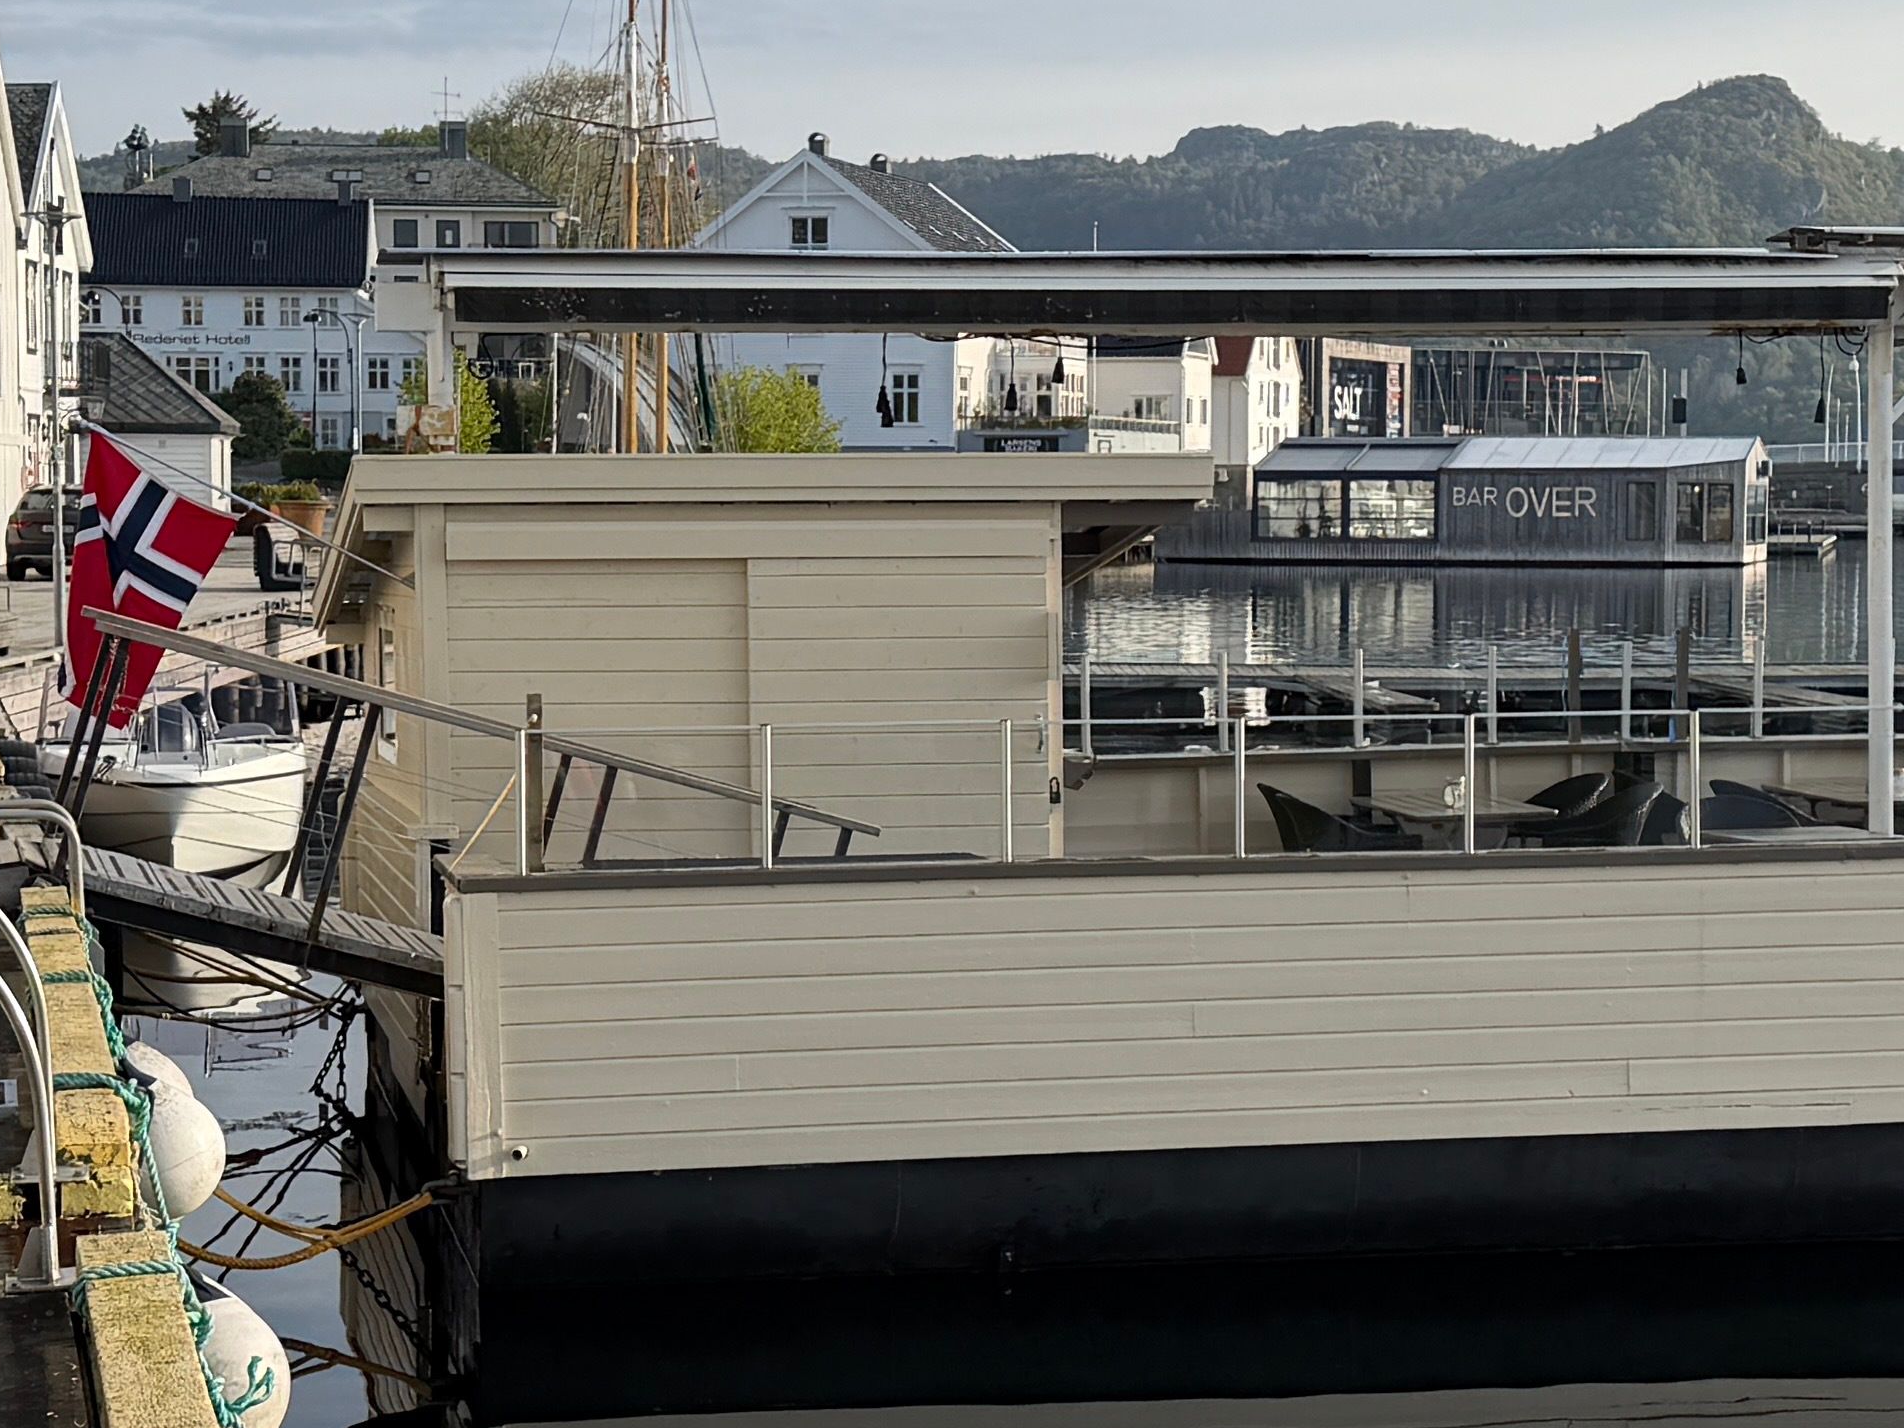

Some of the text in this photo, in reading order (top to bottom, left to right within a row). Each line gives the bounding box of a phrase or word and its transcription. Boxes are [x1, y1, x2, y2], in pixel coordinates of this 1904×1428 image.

[132, 333, 251, 346] Rederiet Hotell
[1334, 385, 1363, 421] SALT
[1452, 486, 1597, 518] BAR OVER
